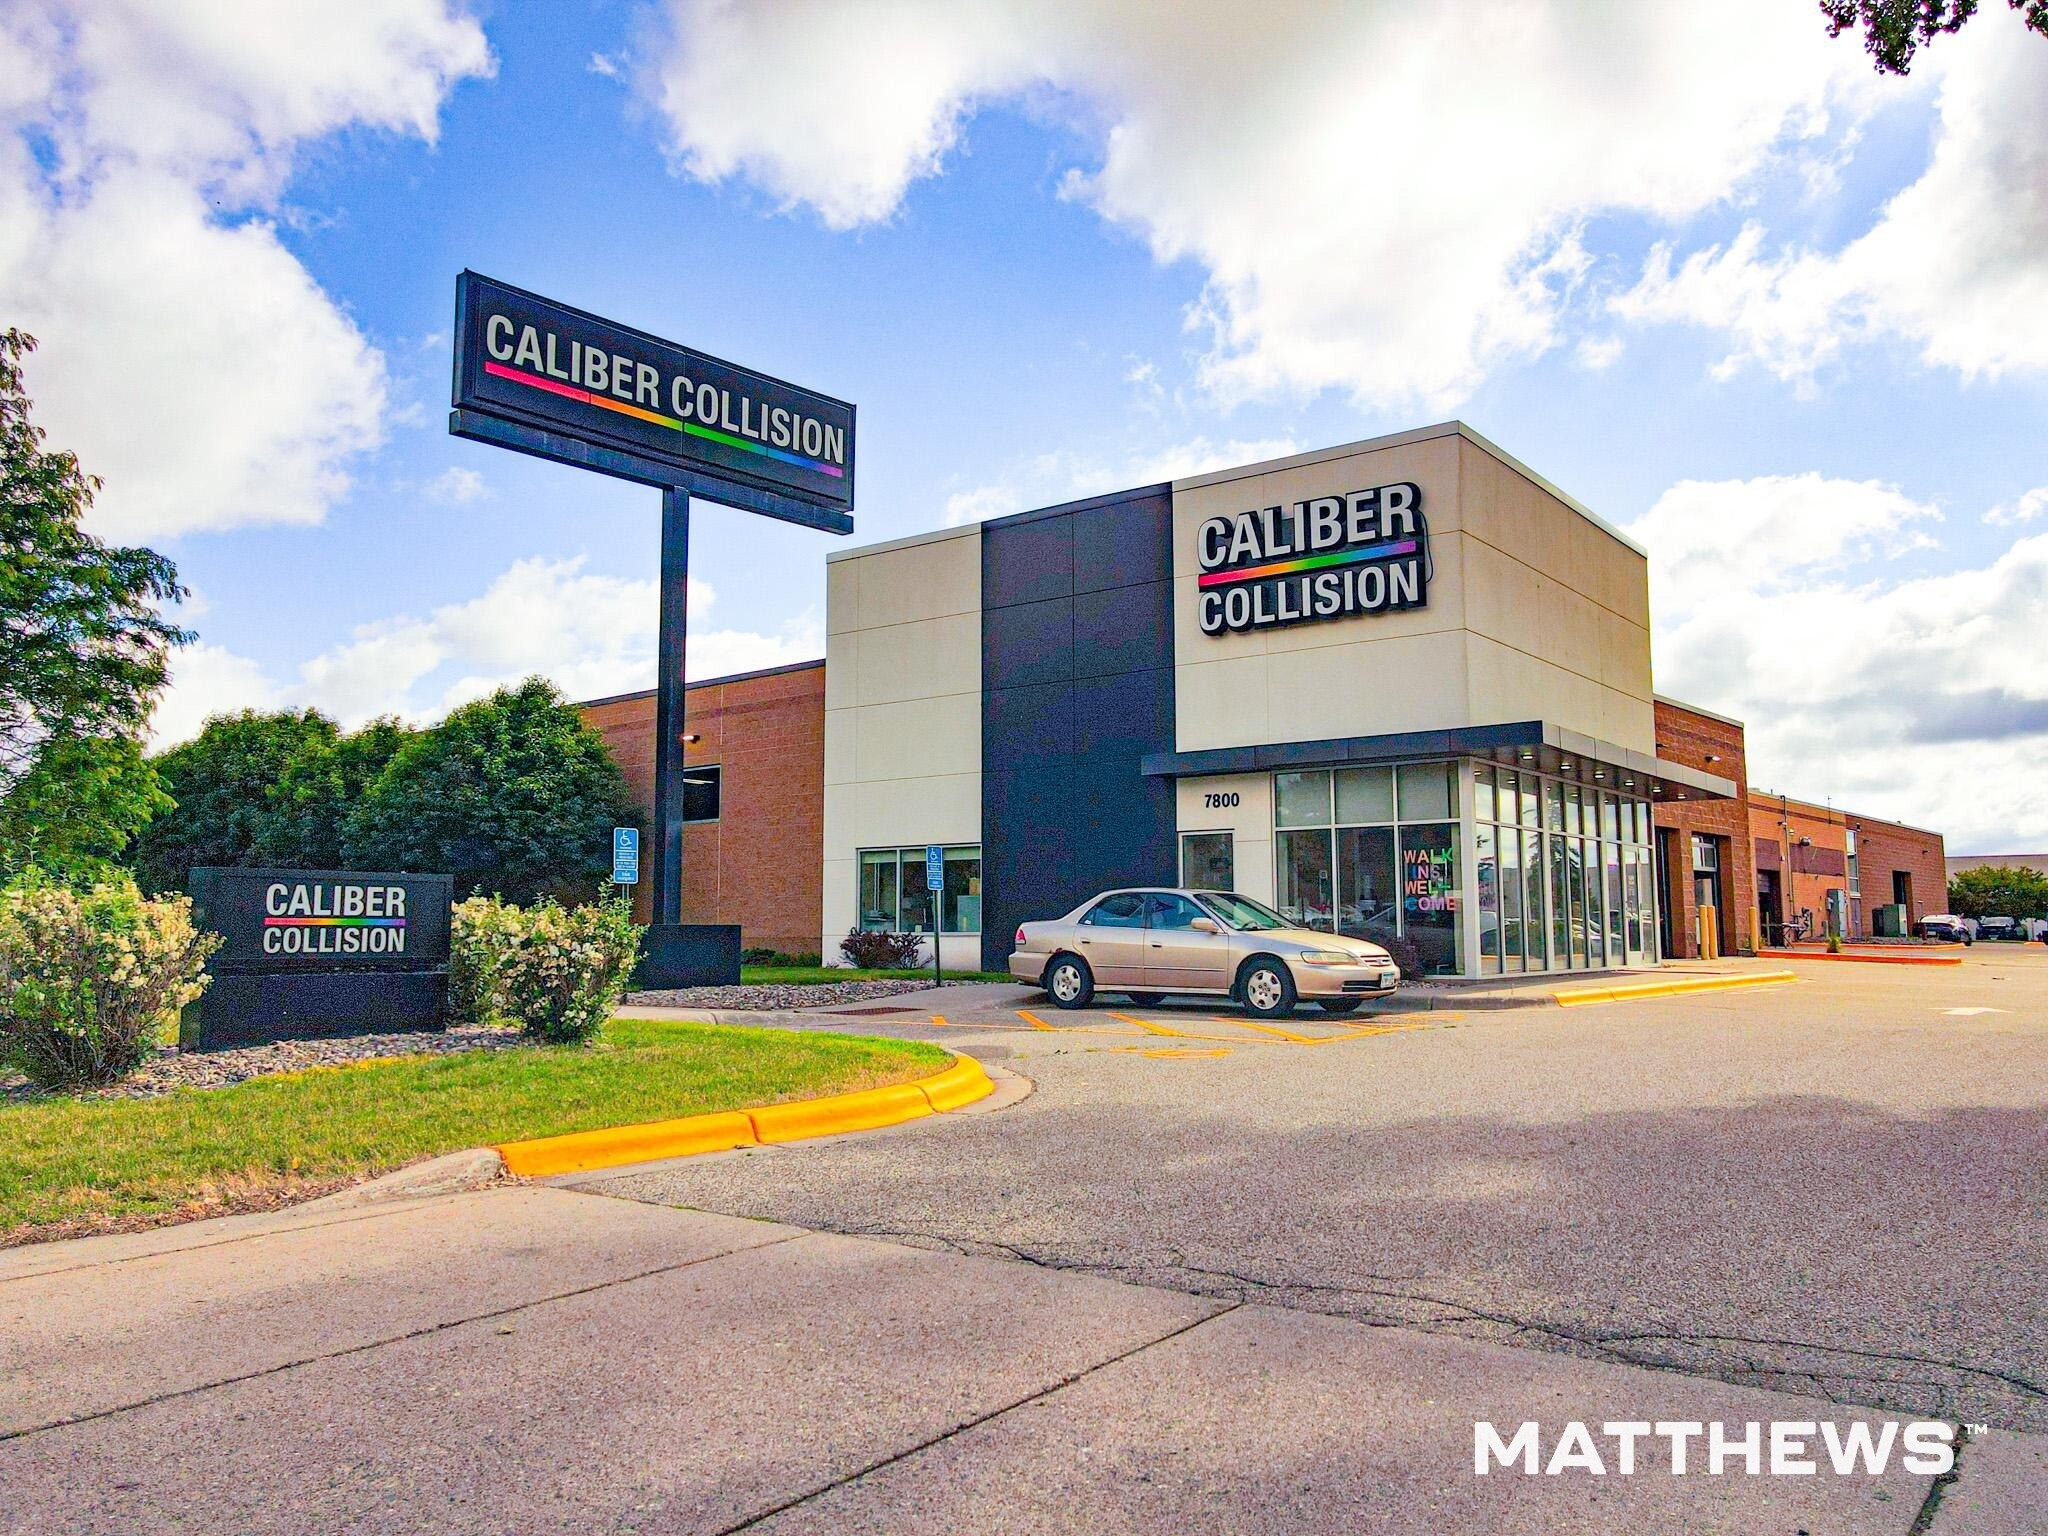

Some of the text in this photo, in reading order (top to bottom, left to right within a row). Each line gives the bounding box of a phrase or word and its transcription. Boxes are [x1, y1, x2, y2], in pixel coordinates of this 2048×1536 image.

[486, 314, 844, 464] CALIBER COLLISION
[1199, 484, 1416, 568] CALIBER
[1200, 560, 1419, 631] COLLISION
[1204, 792, 1240, 808] 7800
[1403, 847, 1454, 864] WALK
[265, 883, 406, 917] CALIBER
[1405, 896, 1457, 911] COME
[263, 927, 405, 954] COLLISION
